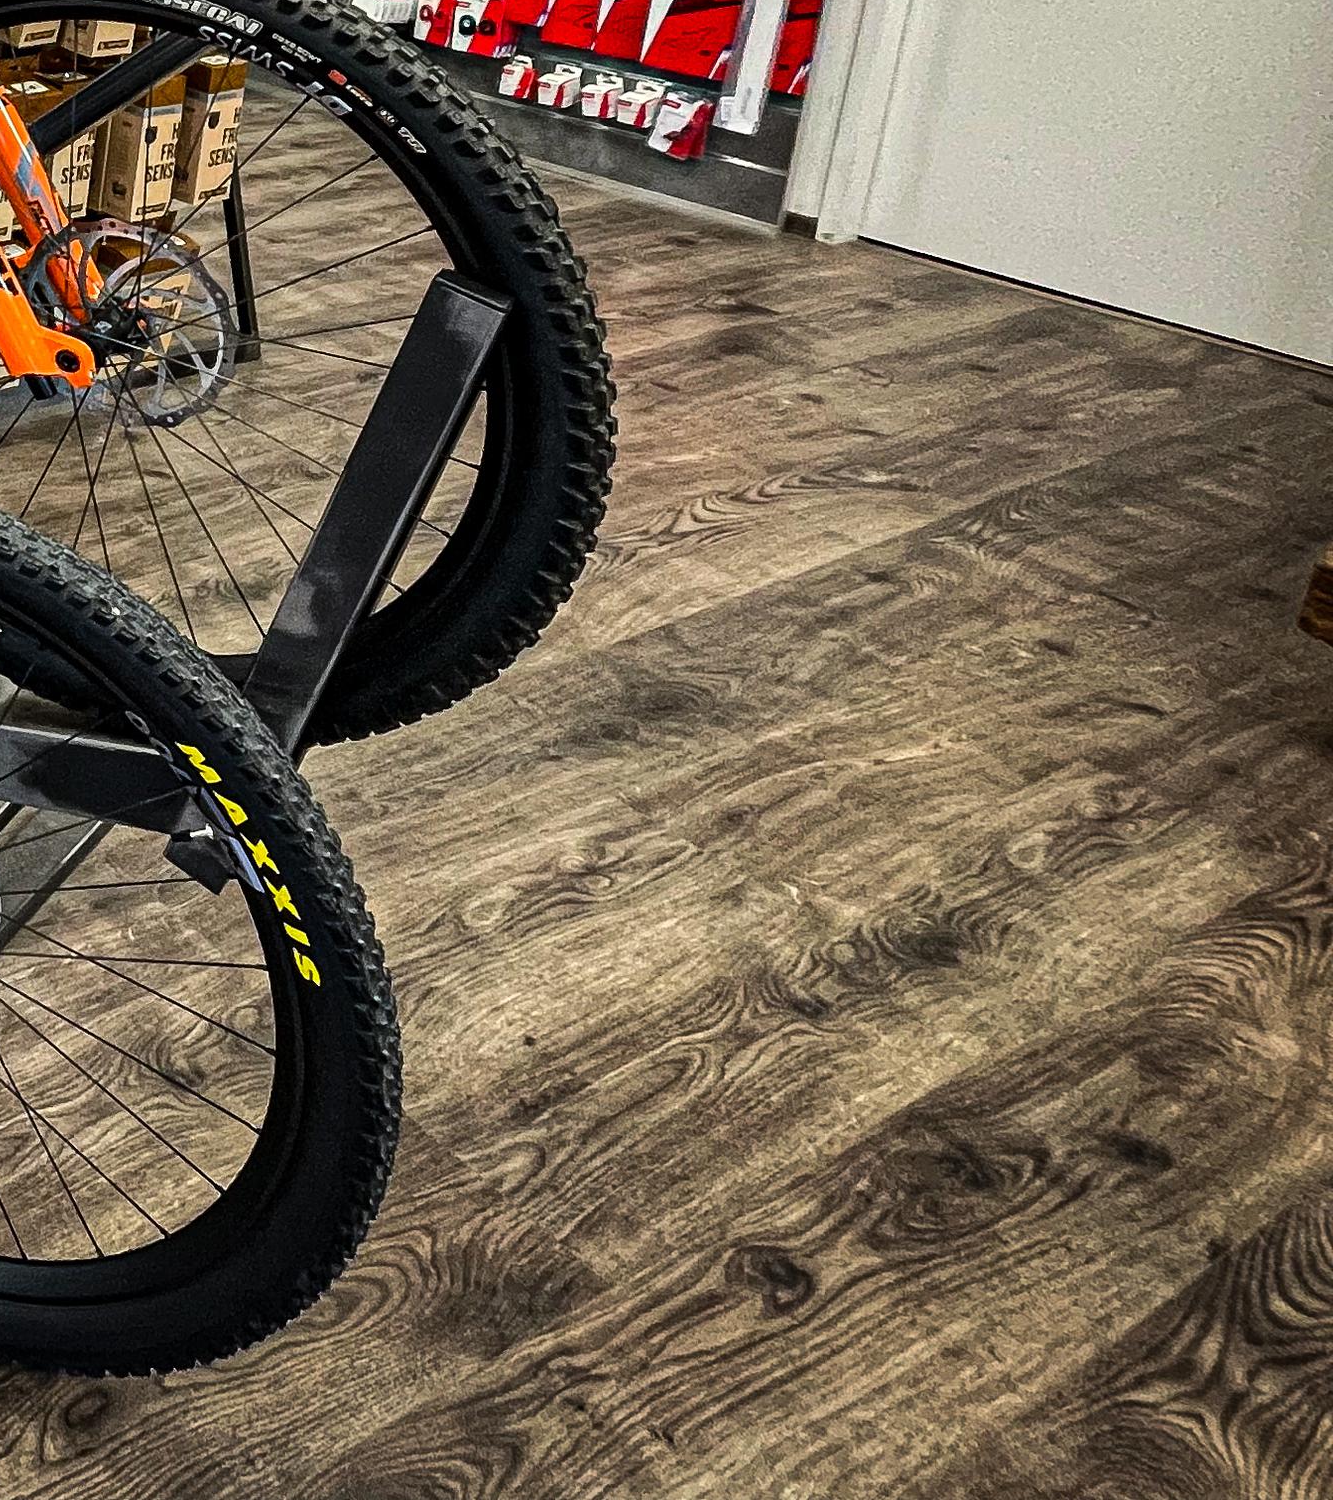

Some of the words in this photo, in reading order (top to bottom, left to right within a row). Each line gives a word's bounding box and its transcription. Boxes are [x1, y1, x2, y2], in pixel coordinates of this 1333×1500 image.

[199, 25, 295, 77] SWISS
[298, 80, 353, 116] DT
[207, 146, 235, 168] SENS
[60, 163, 91, 185] SENS
[145, 162, 174, 183] SENS
[174, 741, 322, 987] MAXXIS
